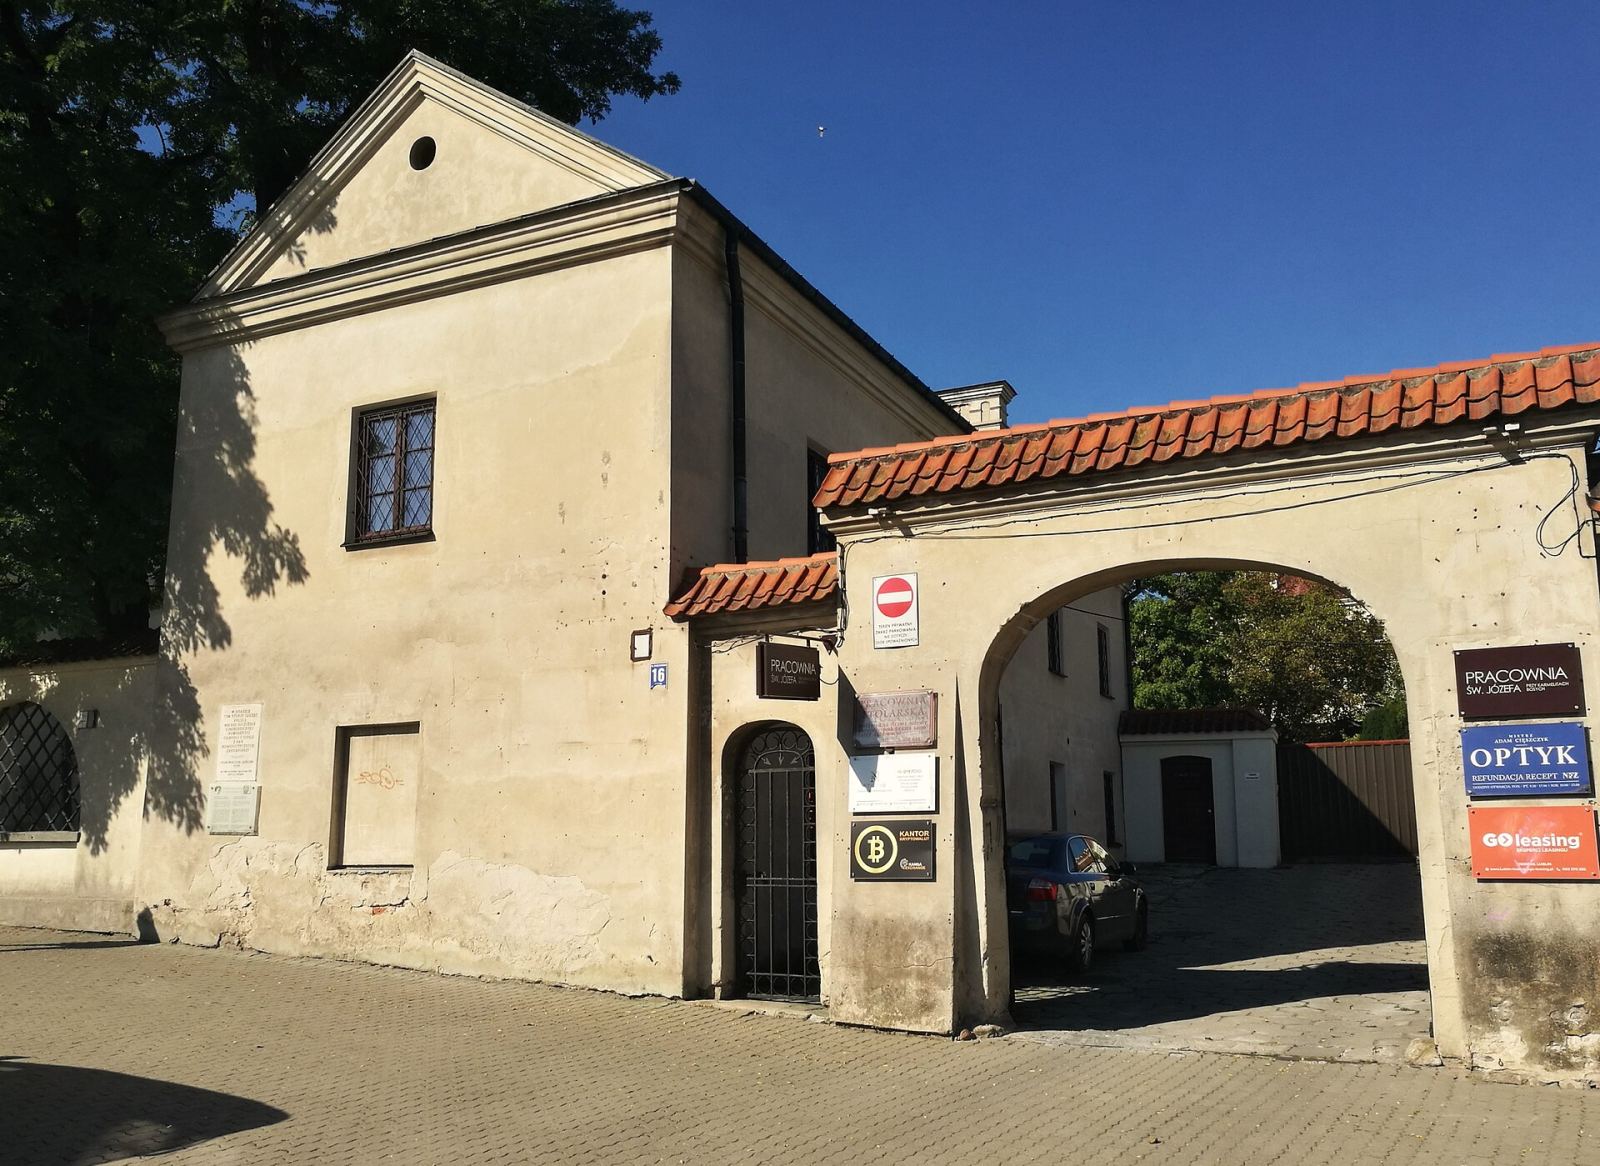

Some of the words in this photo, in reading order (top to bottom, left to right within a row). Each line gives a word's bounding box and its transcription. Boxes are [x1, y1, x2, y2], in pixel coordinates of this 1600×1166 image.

[652, 668, 665, 682] 16
[771, 659, 816, 675] PRACOWNIA
[1466, 666, 1568, 684] PRACOWNIA
[781, 674, 798, 684] JÓZEFA
[1466, 685, 1484, 695] ŚW.
[1486, 684, 1522, 694] JÓZEFA
[1470, 745, 1578, 767] OPTYK
[1515, 833, 1580, 849] leasing
